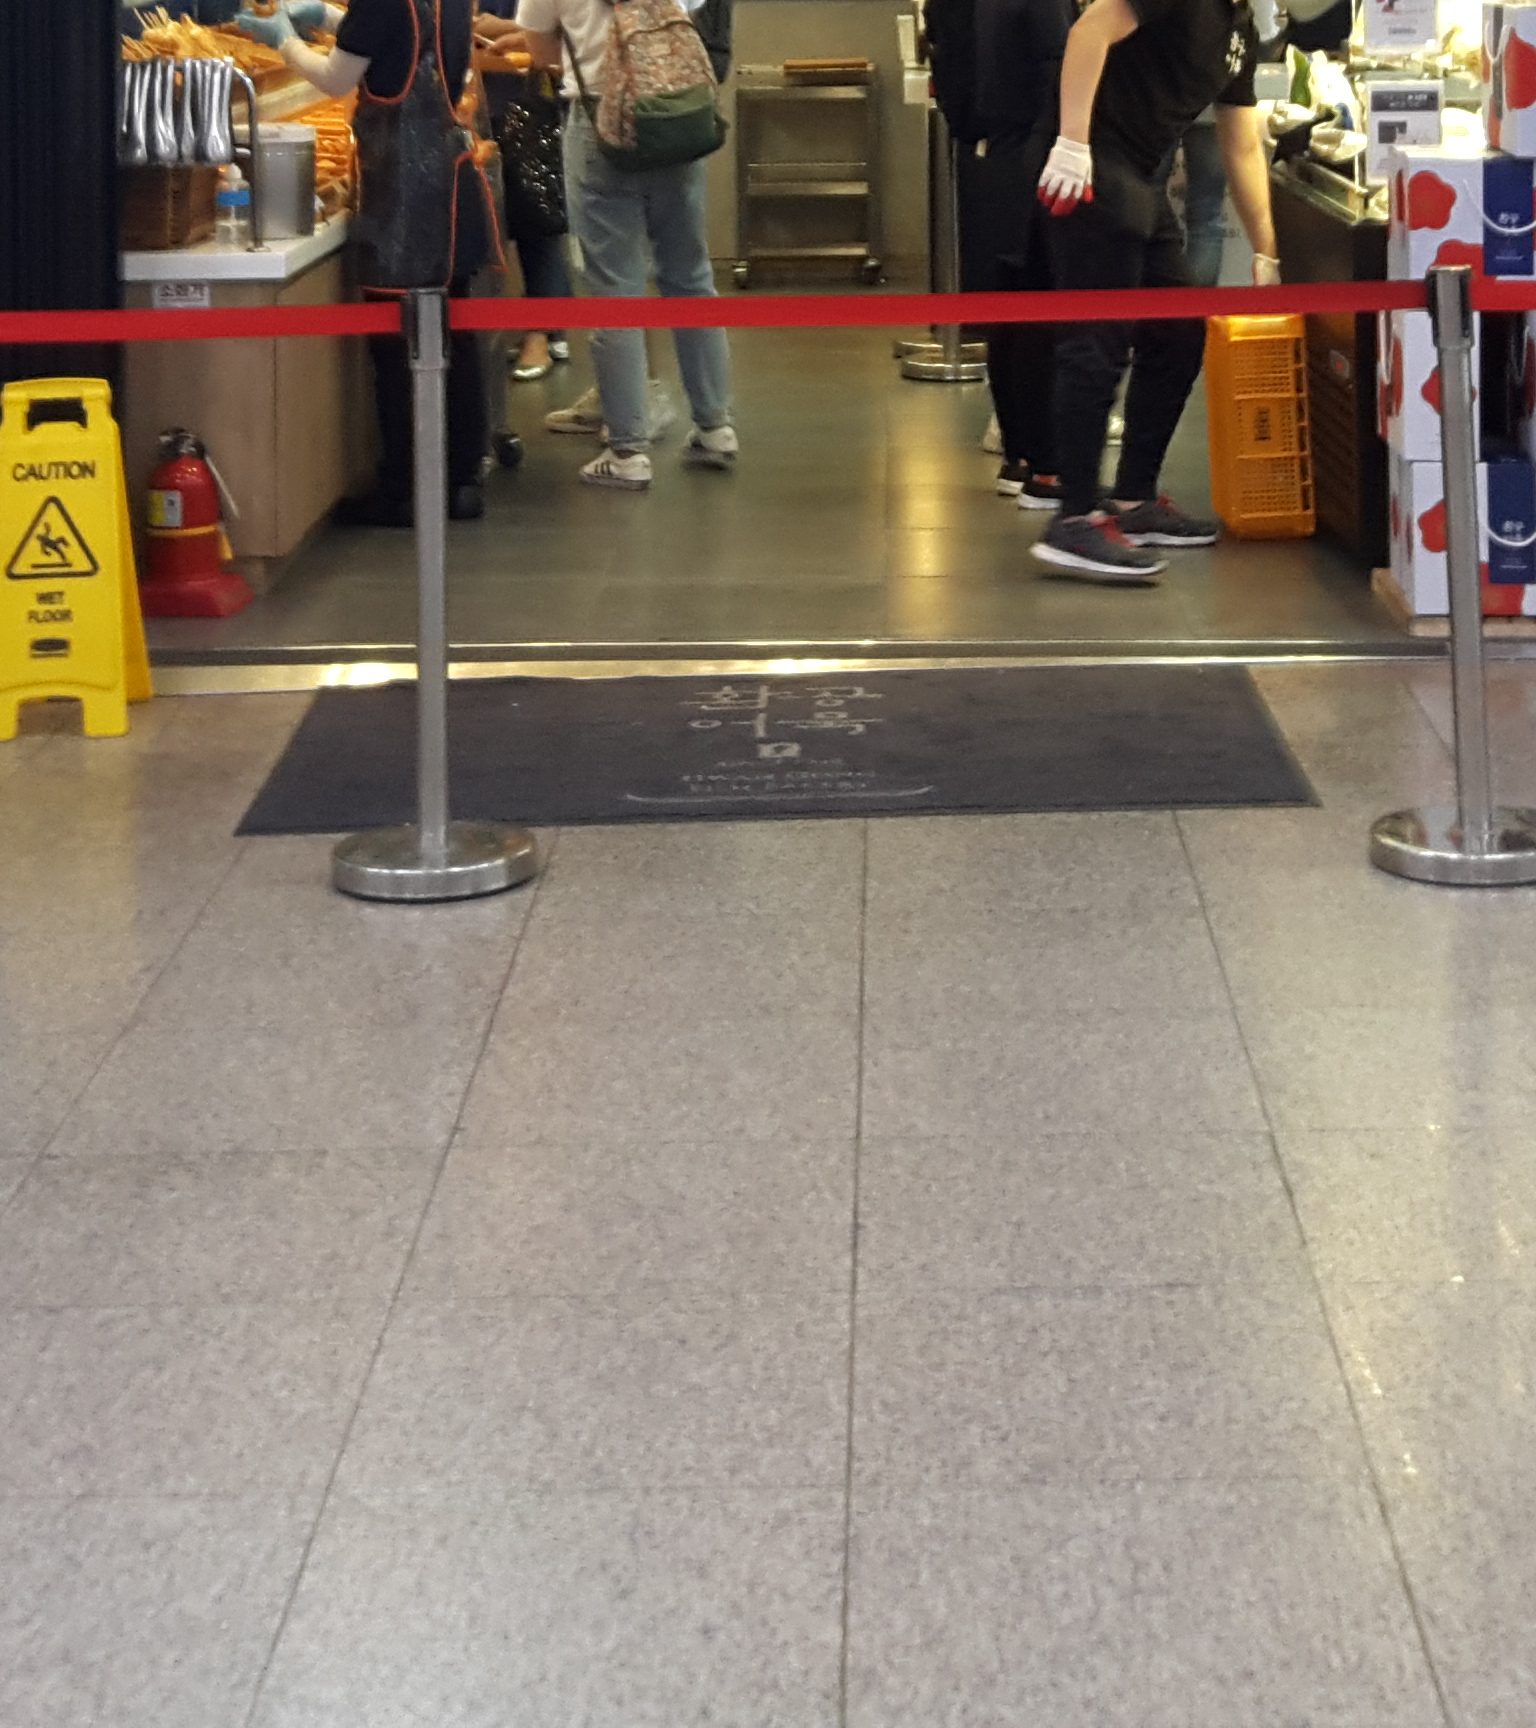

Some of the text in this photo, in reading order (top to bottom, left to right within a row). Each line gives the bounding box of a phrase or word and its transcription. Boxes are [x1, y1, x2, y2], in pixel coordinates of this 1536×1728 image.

[12, 461, 96, 482] CAUTION
[36, 591, 65, 605] WET
[28, 609, 73, 624] FLOOR
